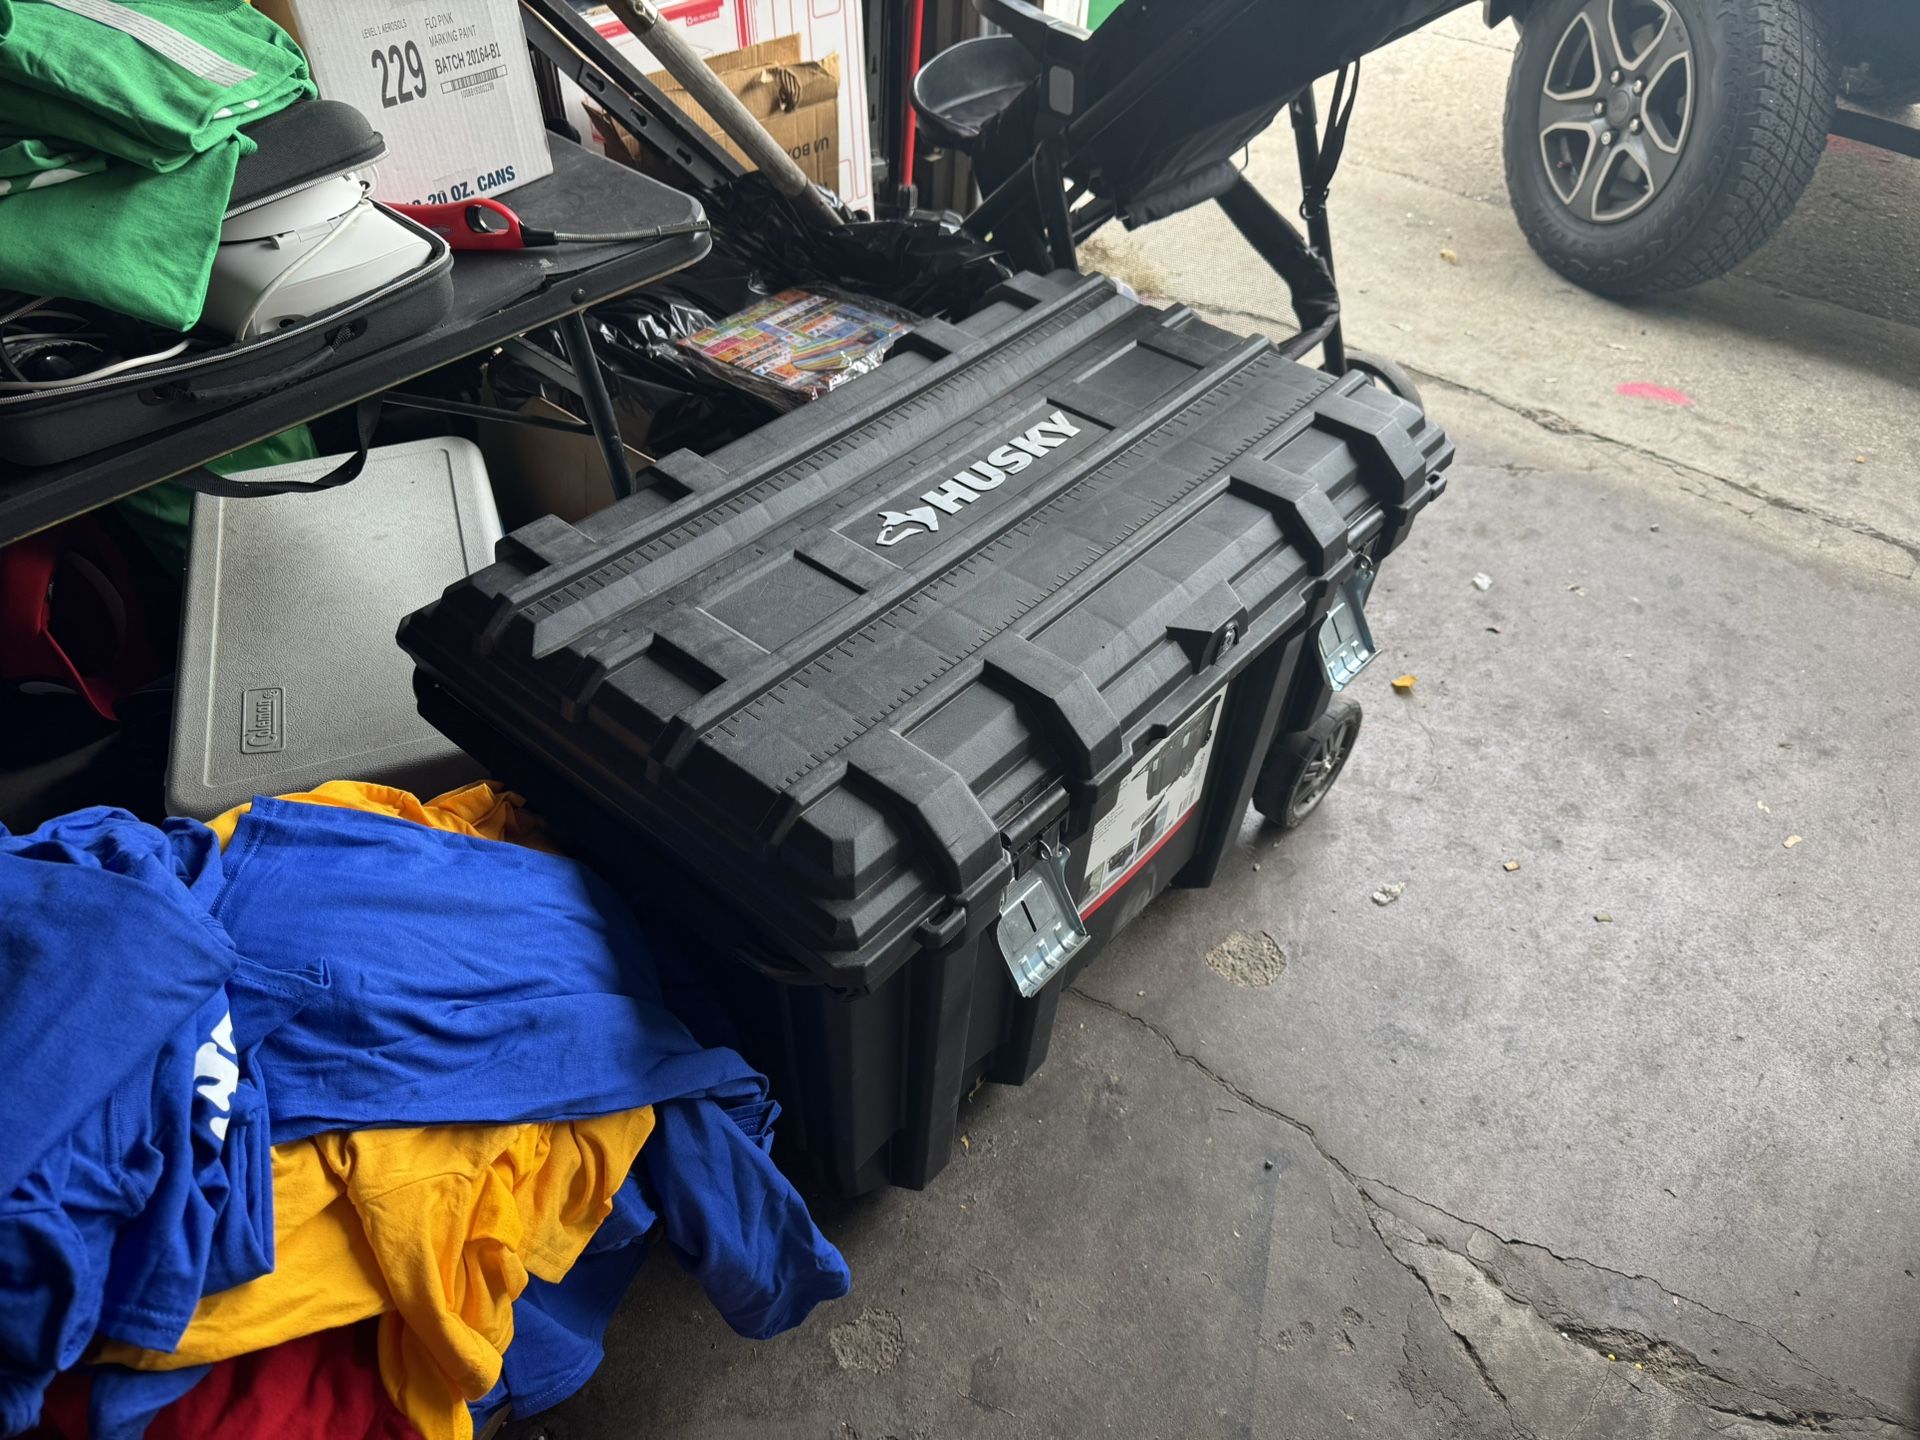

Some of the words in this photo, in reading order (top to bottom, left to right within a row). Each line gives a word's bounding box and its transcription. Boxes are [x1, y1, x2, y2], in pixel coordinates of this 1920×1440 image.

[361, 26, 378, 39] LEVEL
[381, 18, 408, 34] AEROSOLS
[424, 15, 438, 30] FLO
[438, 12, 454, 28] PINK
[428, 30, 458, 47] MARKING
[459, 24, 477, 40] PAINT
[371, 40, 427, 109] 229
[434, 52, 466, 75] BATCH
[465, 42, 502, 67] 20164-B1
[450, 181, 475, 201] OZ.
[477, 165, 516, 192] CANS
[920, 410, 1081, 515] HUSKY
